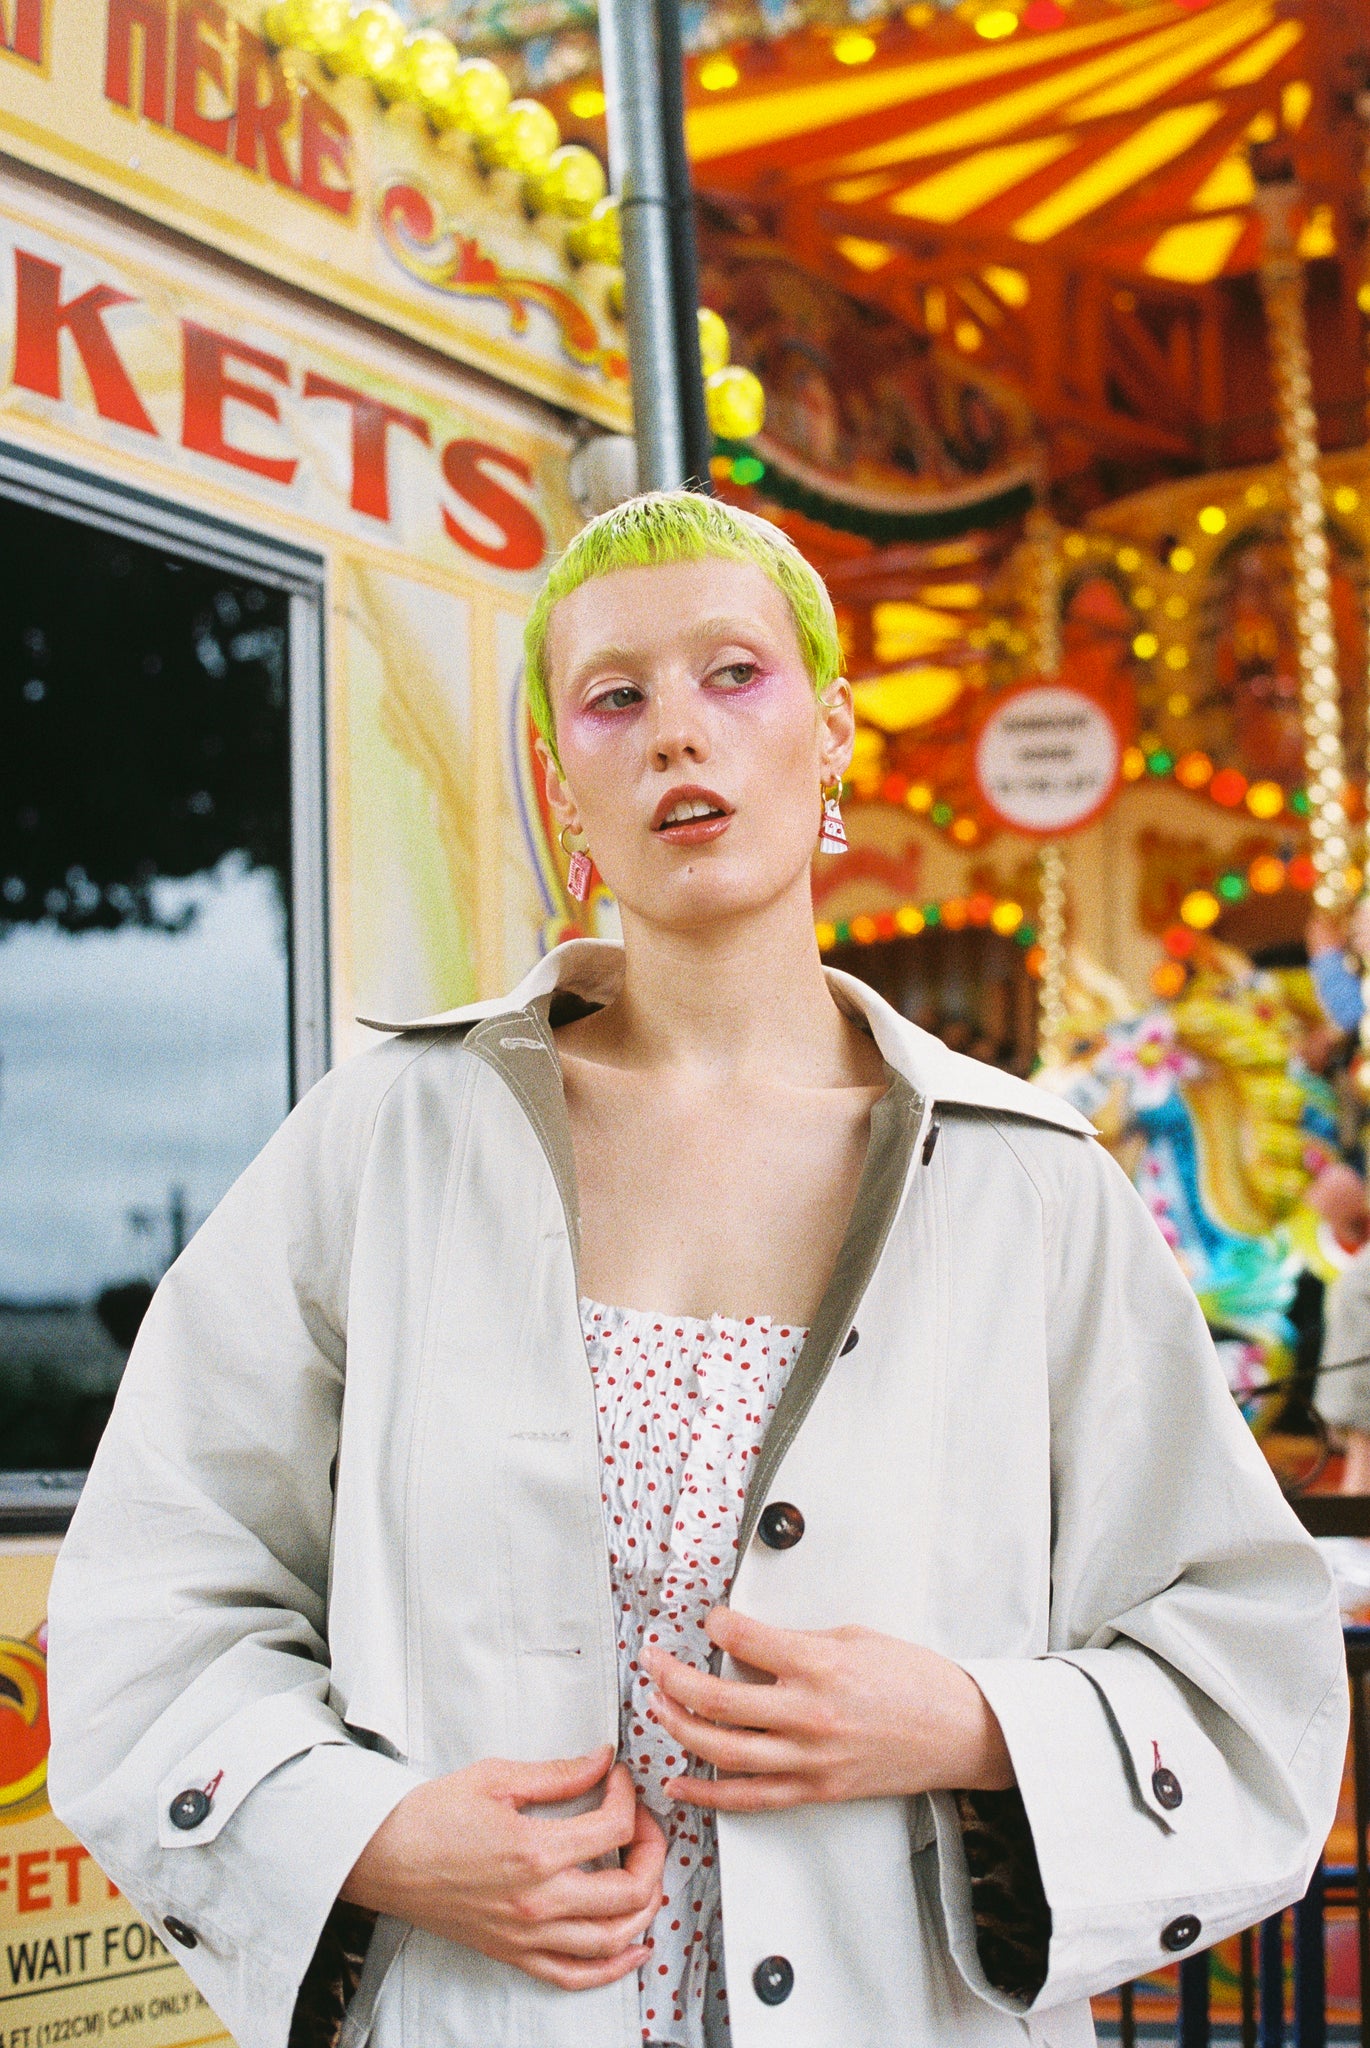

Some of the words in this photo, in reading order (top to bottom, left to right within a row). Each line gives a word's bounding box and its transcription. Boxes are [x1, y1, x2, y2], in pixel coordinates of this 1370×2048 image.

[13, 247, 547, 571] KETS
[7, 1931, 91, 1984] WAIT
[36, 2011, 104, 2048] (122CM)
[107, 2003, 144, 2030] CAN
[147, 1990, 192, 2021] ONLY
